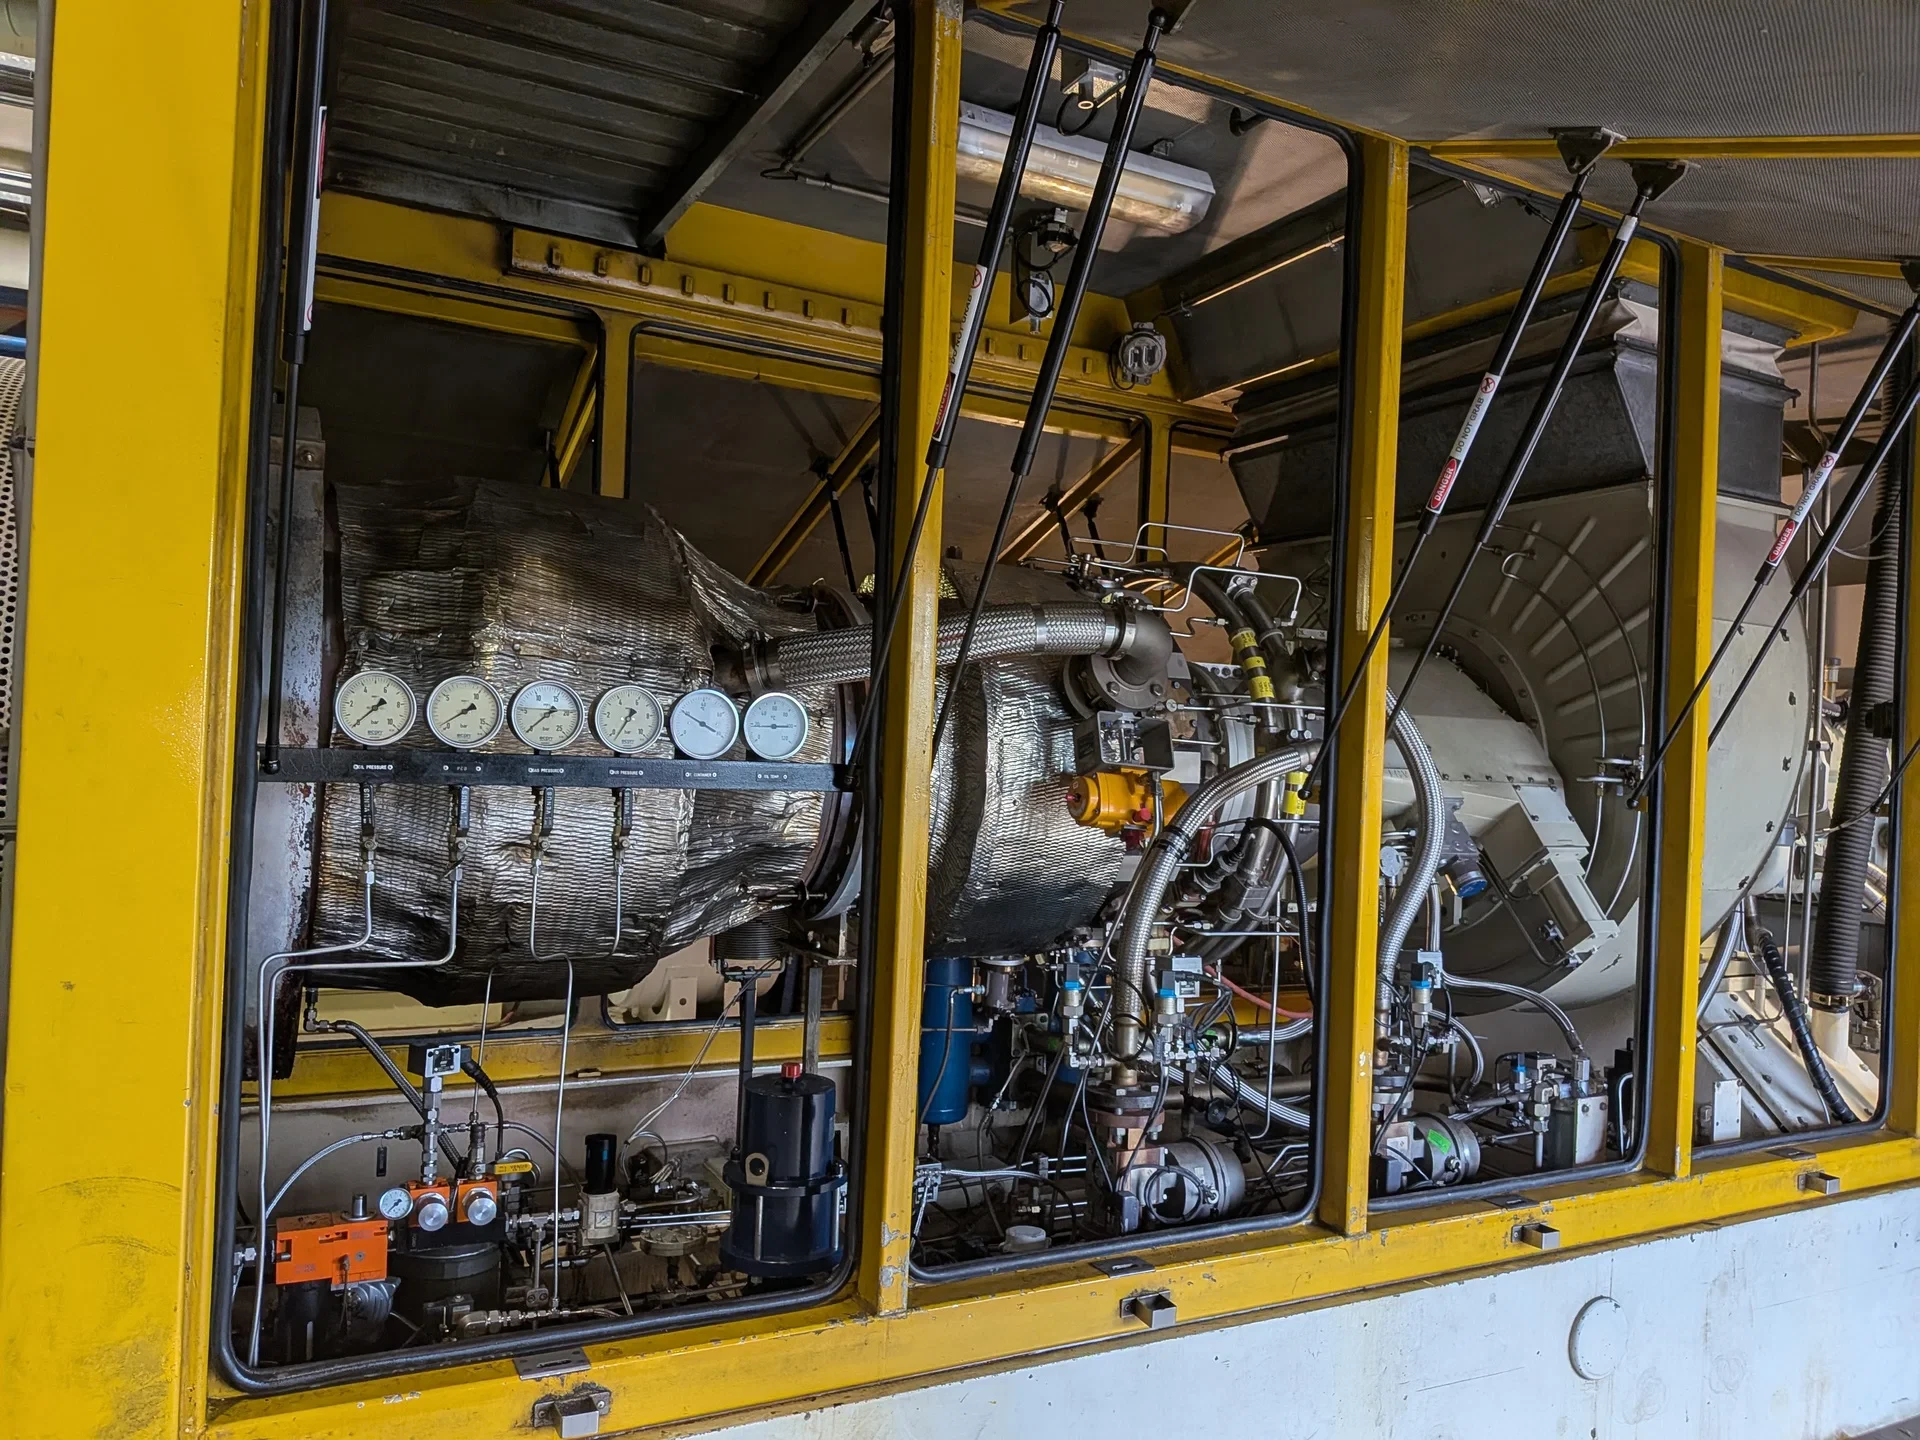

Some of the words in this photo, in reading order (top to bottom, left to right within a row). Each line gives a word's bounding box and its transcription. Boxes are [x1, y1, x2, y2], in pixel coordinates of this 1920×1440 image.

[1455, 441, 1465, 453] DO
[1461, 423, 1473, 440] NOT
[1470, 398, 1485, 421] GRAB
[1434, 467, 1454, 502] DANGER
[1794, 506, 1804, 517] DO
[1802, 492, 1813, 506] NOT
[1808, 471, 1824, 490] GRAB
[1772, 527, 1793, 556] DANGER
[349, 699, 354, 708] 2
[383, 686, 388, 694] 6
[535, 694, 542, 702] 10
[387, 718, 394, 726] 10
[363, 787, 371, 814] VENUS
[460, 788, 469, 815] VENUS
[545, 791, 554, 815] VENUS
